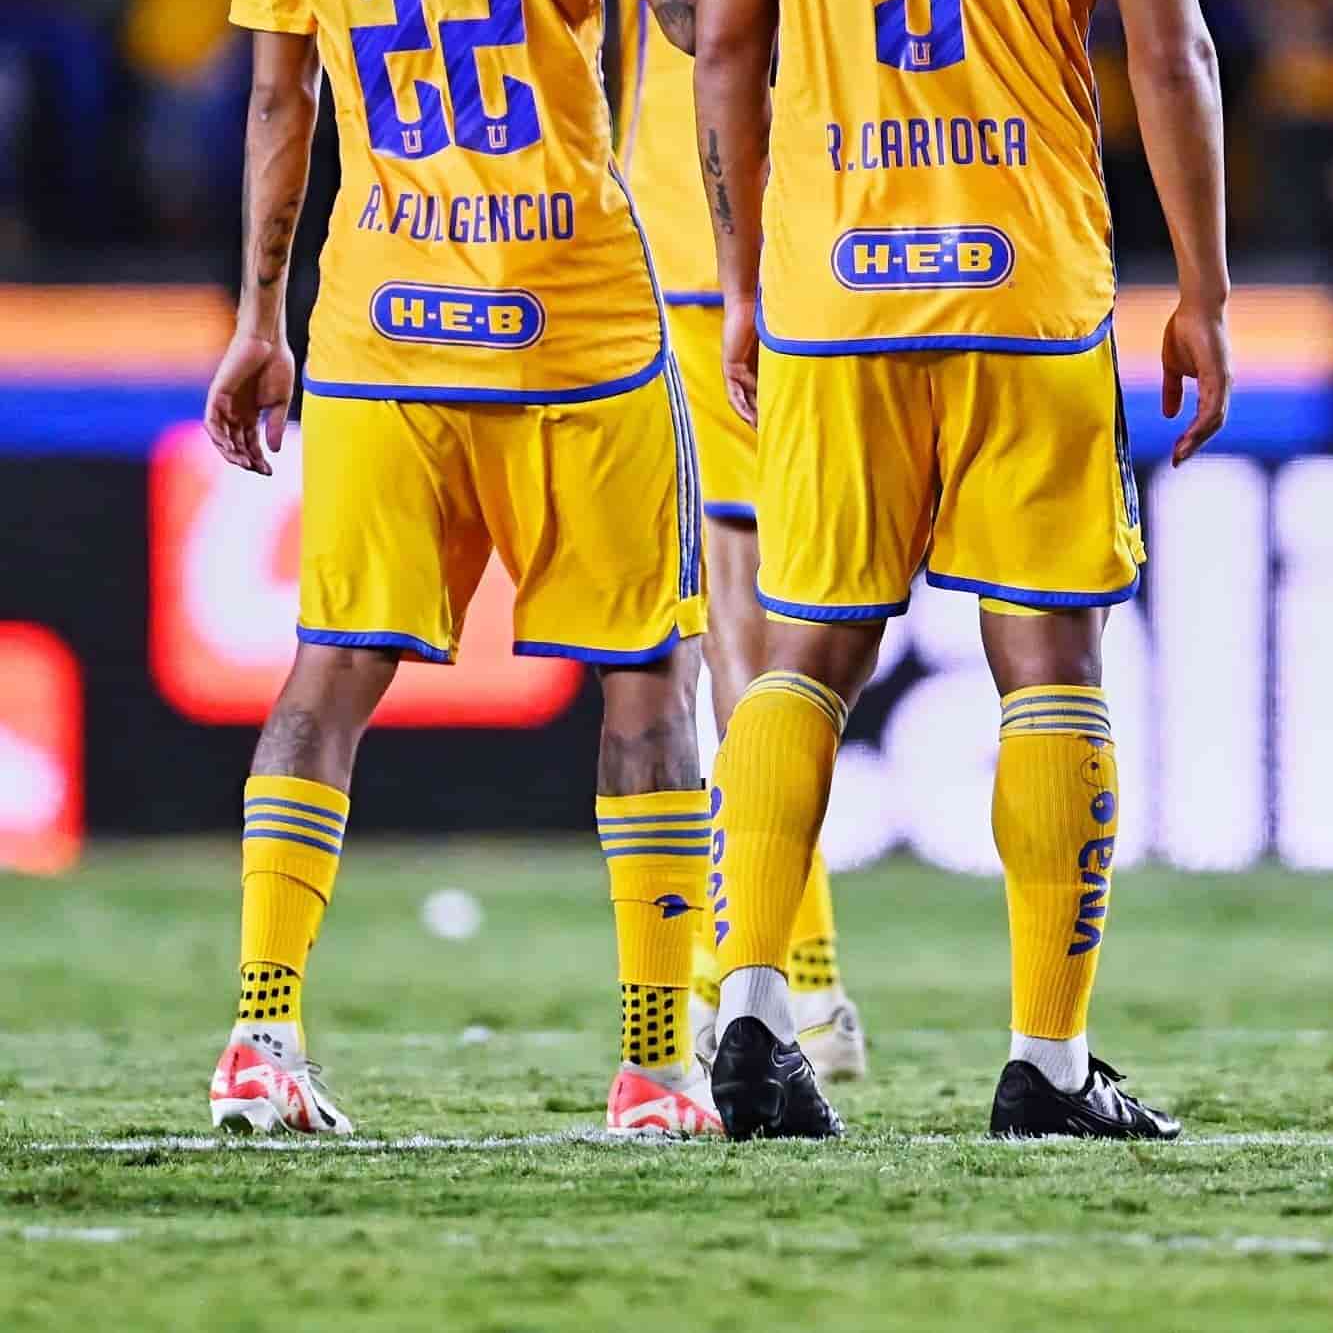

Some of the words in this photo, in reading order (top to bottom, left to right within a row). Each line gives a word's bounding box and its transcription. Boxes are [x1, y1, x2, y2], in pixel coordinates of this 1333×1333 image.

[826, 117, 1028, 171] R.CARIOCA
[357, 184, 575, 243] R.FULGENCIO
[1066, 835, 1116, 957] viva
